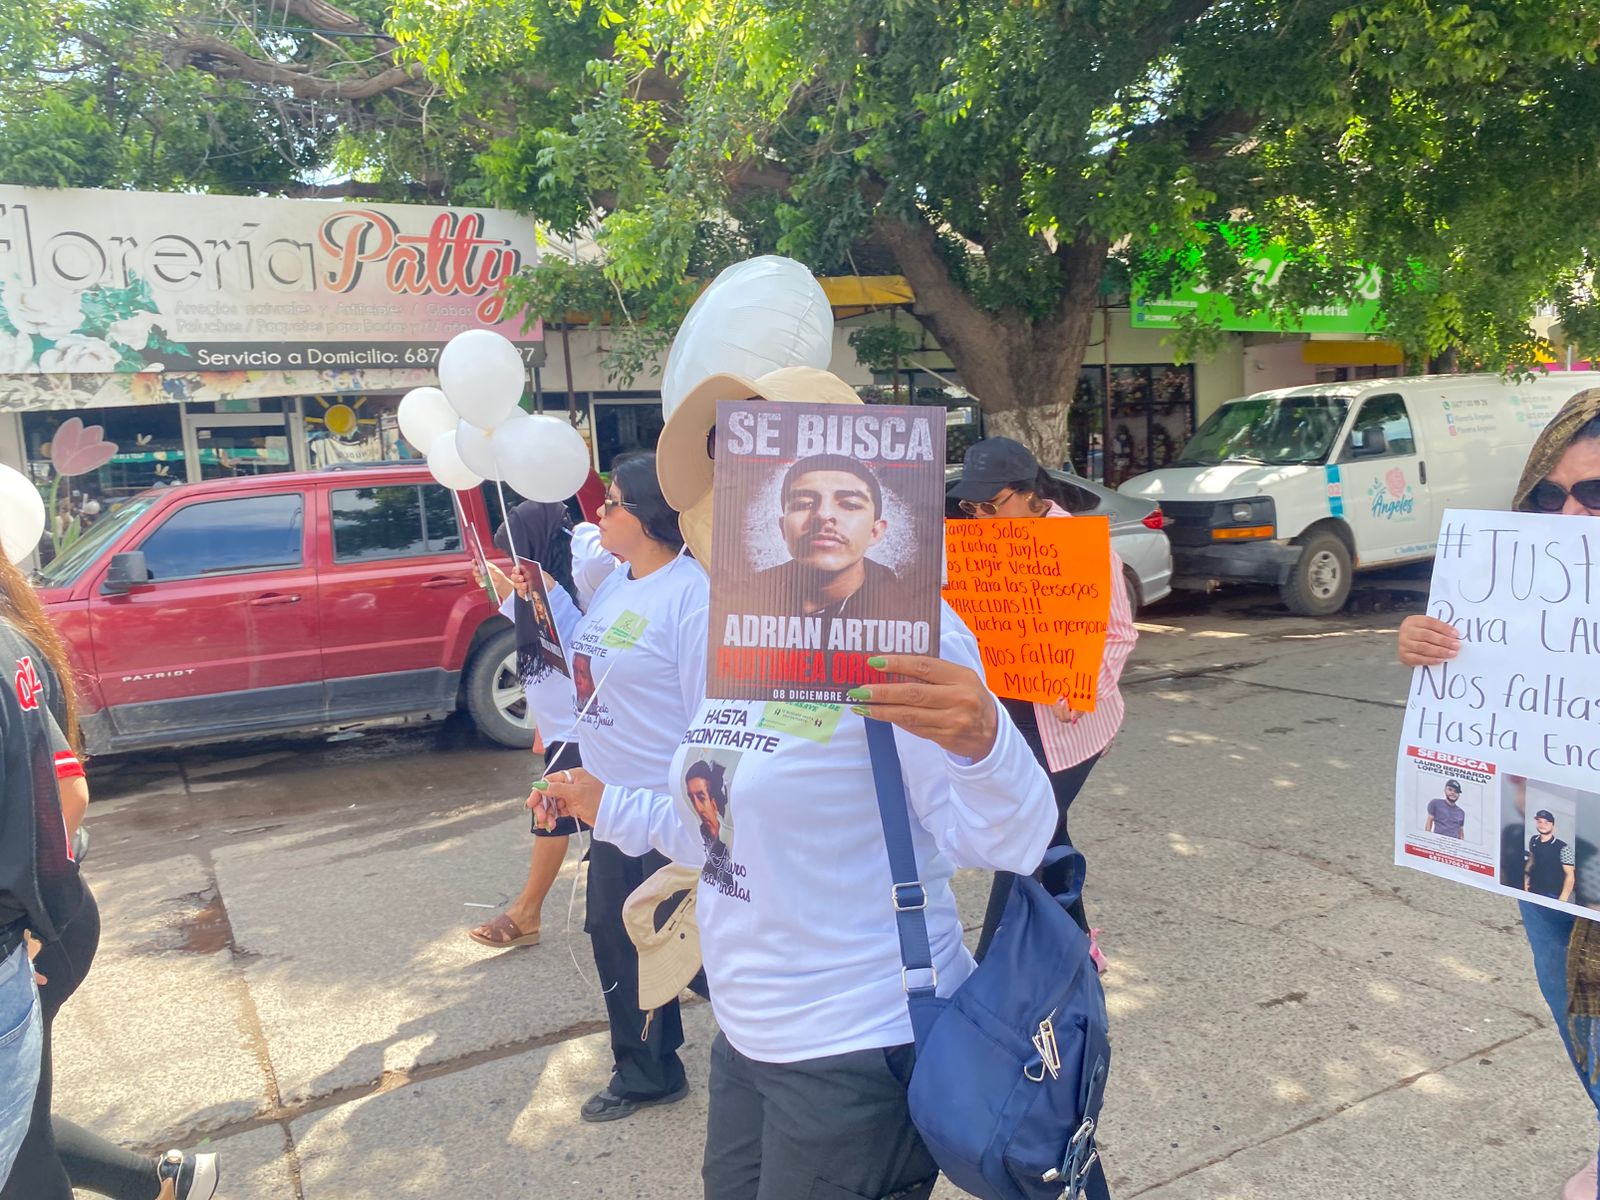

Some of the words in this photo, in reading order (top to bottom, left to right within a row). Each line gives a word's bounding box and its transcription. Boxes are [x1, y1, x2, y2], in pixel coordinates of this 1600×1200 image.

[318, 208, 521, 325] Patty
[197, 349, 282, 366] Servicio
[288, 352, 303, 365] a
[307, 348, 399, 366] Domicilio:
[404, 348, 440, 364] 687
[727, 410, 781, 455] SE
[796, 413, 934, 461] BUSCA
[961, 540, 998, 553] Lucha
[1008, 560, 1062, 577] Verdad
[972, 576, 1001, 593] Para
[1004, 576, 1028, 594] las
[1031, 579, 1098, 601] Personas
[723, 614, 823, 651] ADRIAN
[828, 617, 931, 655] ARTURO
[974, 616, 1011, 632] lucha
[1017, 619, 1026, 638] y
[1032, 617, 1049, 633] la
[122, 668, 196, 683] PATRIOT
[1417, 661, 1486, 710] Nos
[772, 688, 786, 700] 08
[789, 689, 842, 702] DICIEMBRE
[703, 708, 748, 727] HASTA
[1414, 758, 1442, 769] LAURO
[1443, 765, 1492, 780] BERNARDO
[1417, 748, 1436, 759] SE
[1436, 752, 1489, 771] BUSCA
[1417, 764, 1444, 775] LOPEZ
[1445, 770, 1487, 784] ESTRELLA
